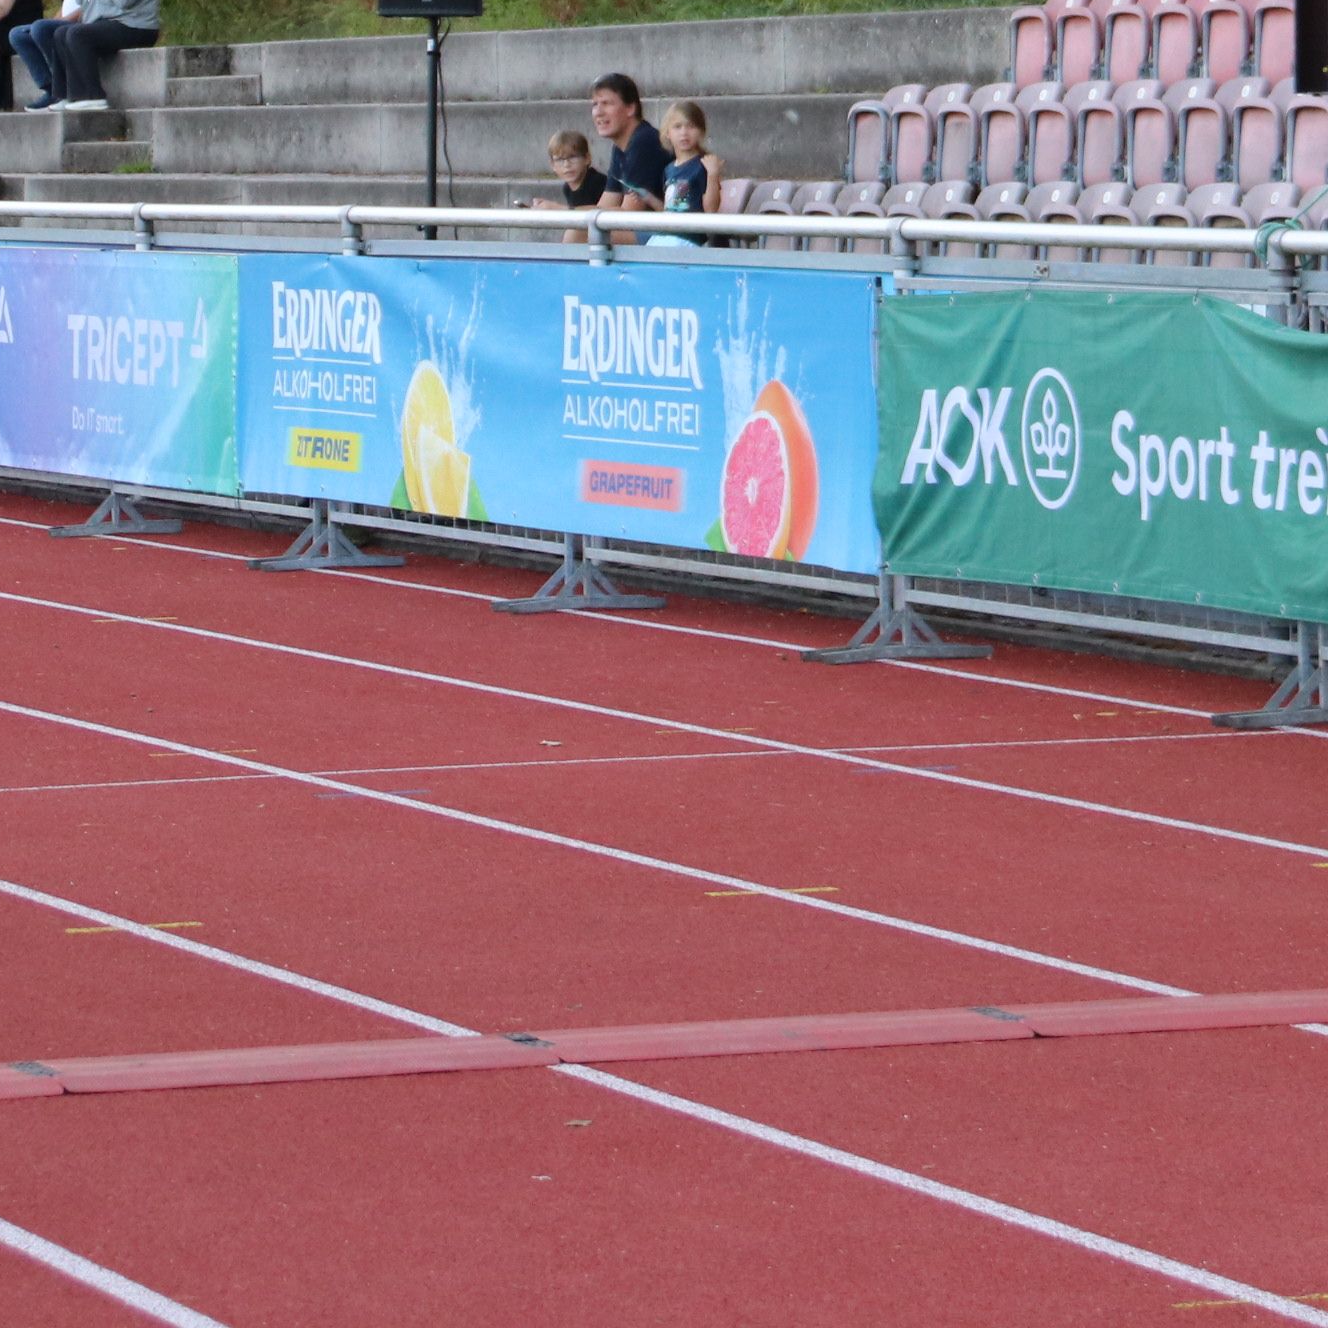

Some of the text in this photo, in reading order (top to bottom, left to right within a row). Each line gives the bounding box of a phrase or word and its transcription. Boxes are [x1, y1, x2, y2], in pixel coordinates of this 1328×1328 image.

[67, 313, 184, 388] TRICEPT
[272, 281, 382, 364] ERDINGER
[562, 295, 704, 390] ERDINGER
[72, 406, 85, 430] Do
[272, 369, 376, 404] ALKOHOLFREI
[563, 394, 700, 435] ALKOHOLFREI
[900, 386, 1018, 487] AOK
[1110, 409, 1240, 520] Sport
[589, 471, 674, 499] GRAPEFRUIT
